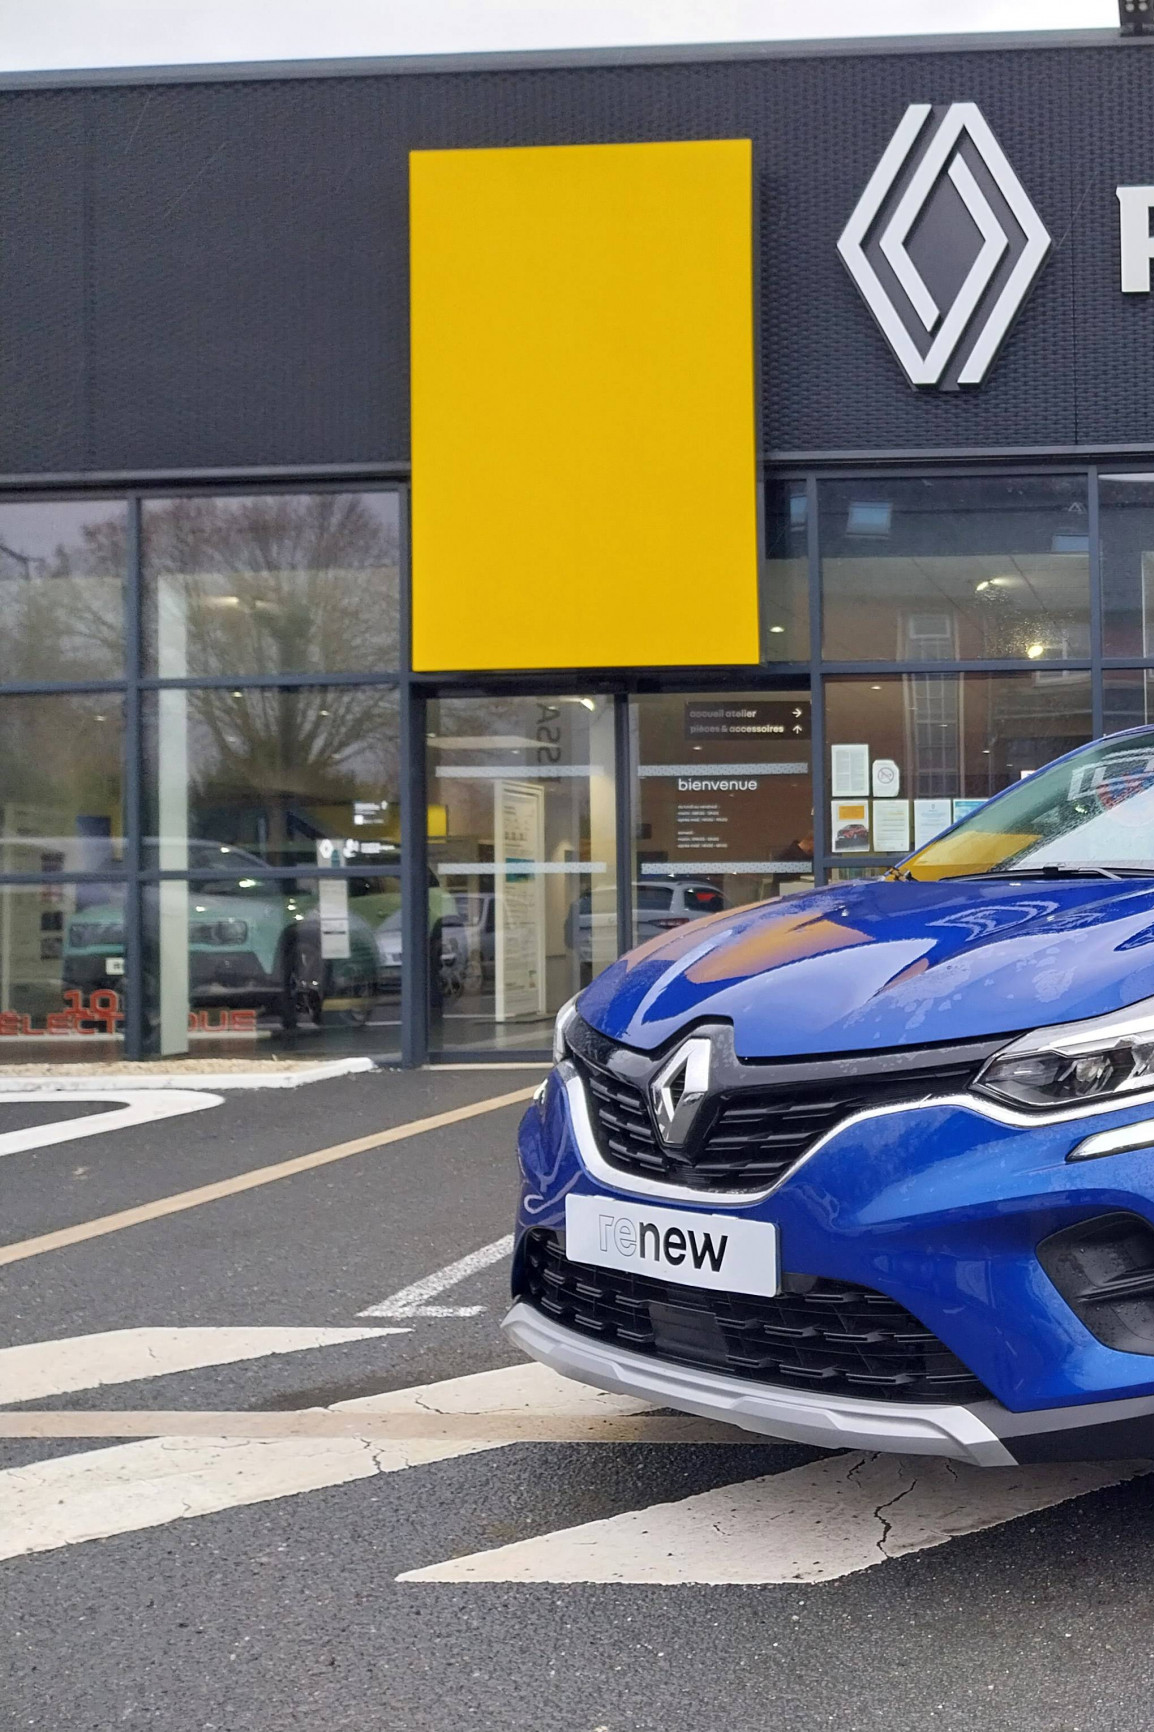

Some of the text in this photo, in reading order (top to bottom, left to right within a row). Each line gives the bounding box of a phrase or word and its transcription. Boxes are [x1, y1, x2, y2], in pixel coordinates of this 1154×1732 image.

[689, 709, 757, 718] accueil atelier
[721, 725, 728, 733] &
[729, 725, 784, 733] accessoires
[678, 778, 758, 791] bienvenue
[598, 1214, 728, 1272] renew
